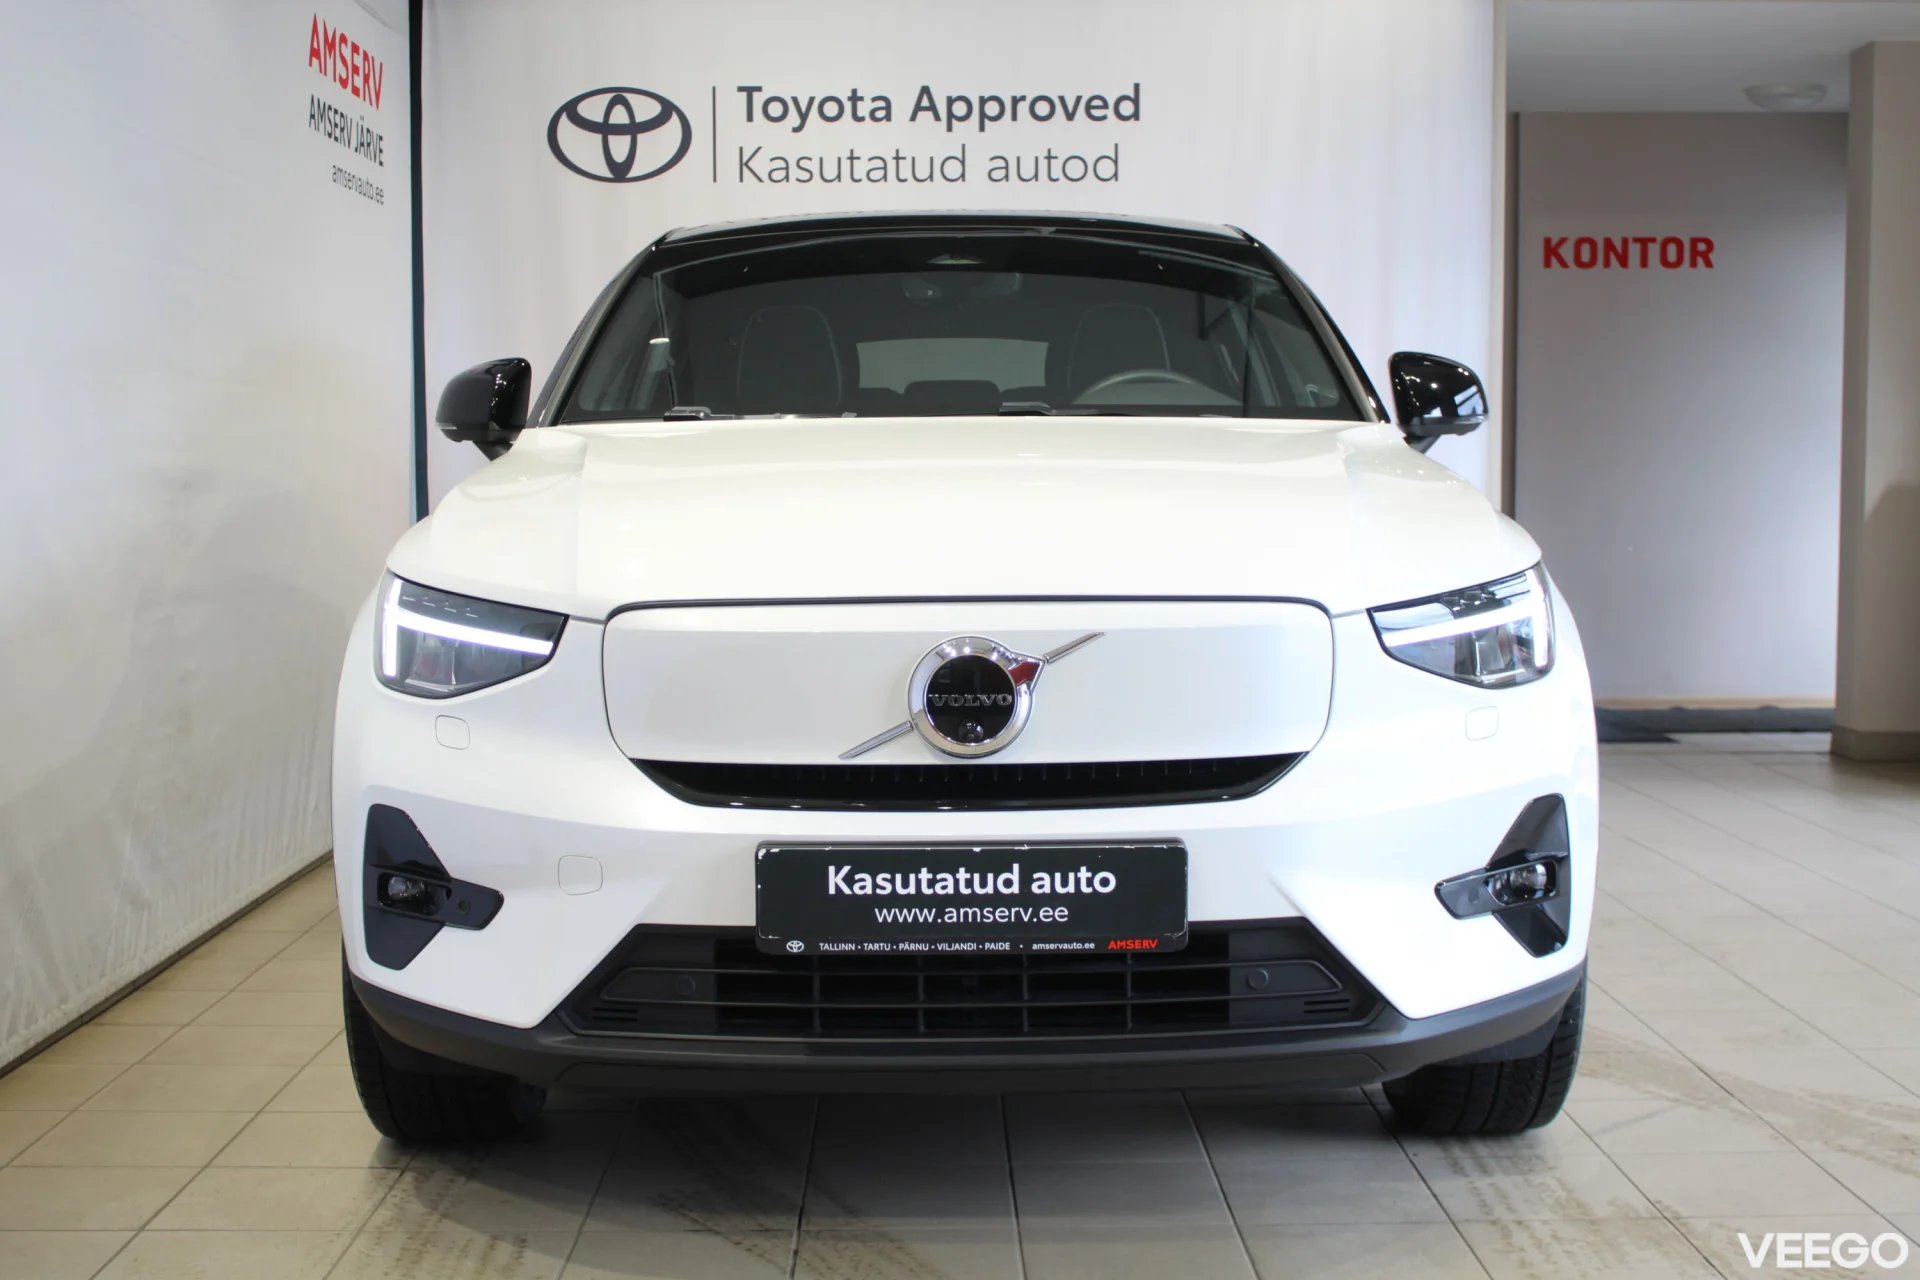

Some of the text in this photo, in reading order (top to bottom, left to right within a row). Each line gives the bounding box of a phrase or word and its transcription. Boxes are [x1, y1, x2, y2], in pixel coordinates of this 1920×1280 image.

[309, 12, 383, 110] AMSERV
[737, 83, 1141, 132] Toyota Approved
[309, 94, 384, 167] AMSERV JÄRVE
[738, 143, 1120, 183] Kasutatud autod
[332, 164, 384, 205] amservauto.ee
[1543, 236, 1714, 269] KONTOR
[928, 692, 1013, 707] VOLVO
[827, 863, 1117, 895] Kasutatud auto
[874, 904, 1069, 923] www.amserv.ee
[819, 939, 1158, 951] TALLINN TARTU PÄRNU VILJANDI PAIDE amservauto.ee AMSERV
